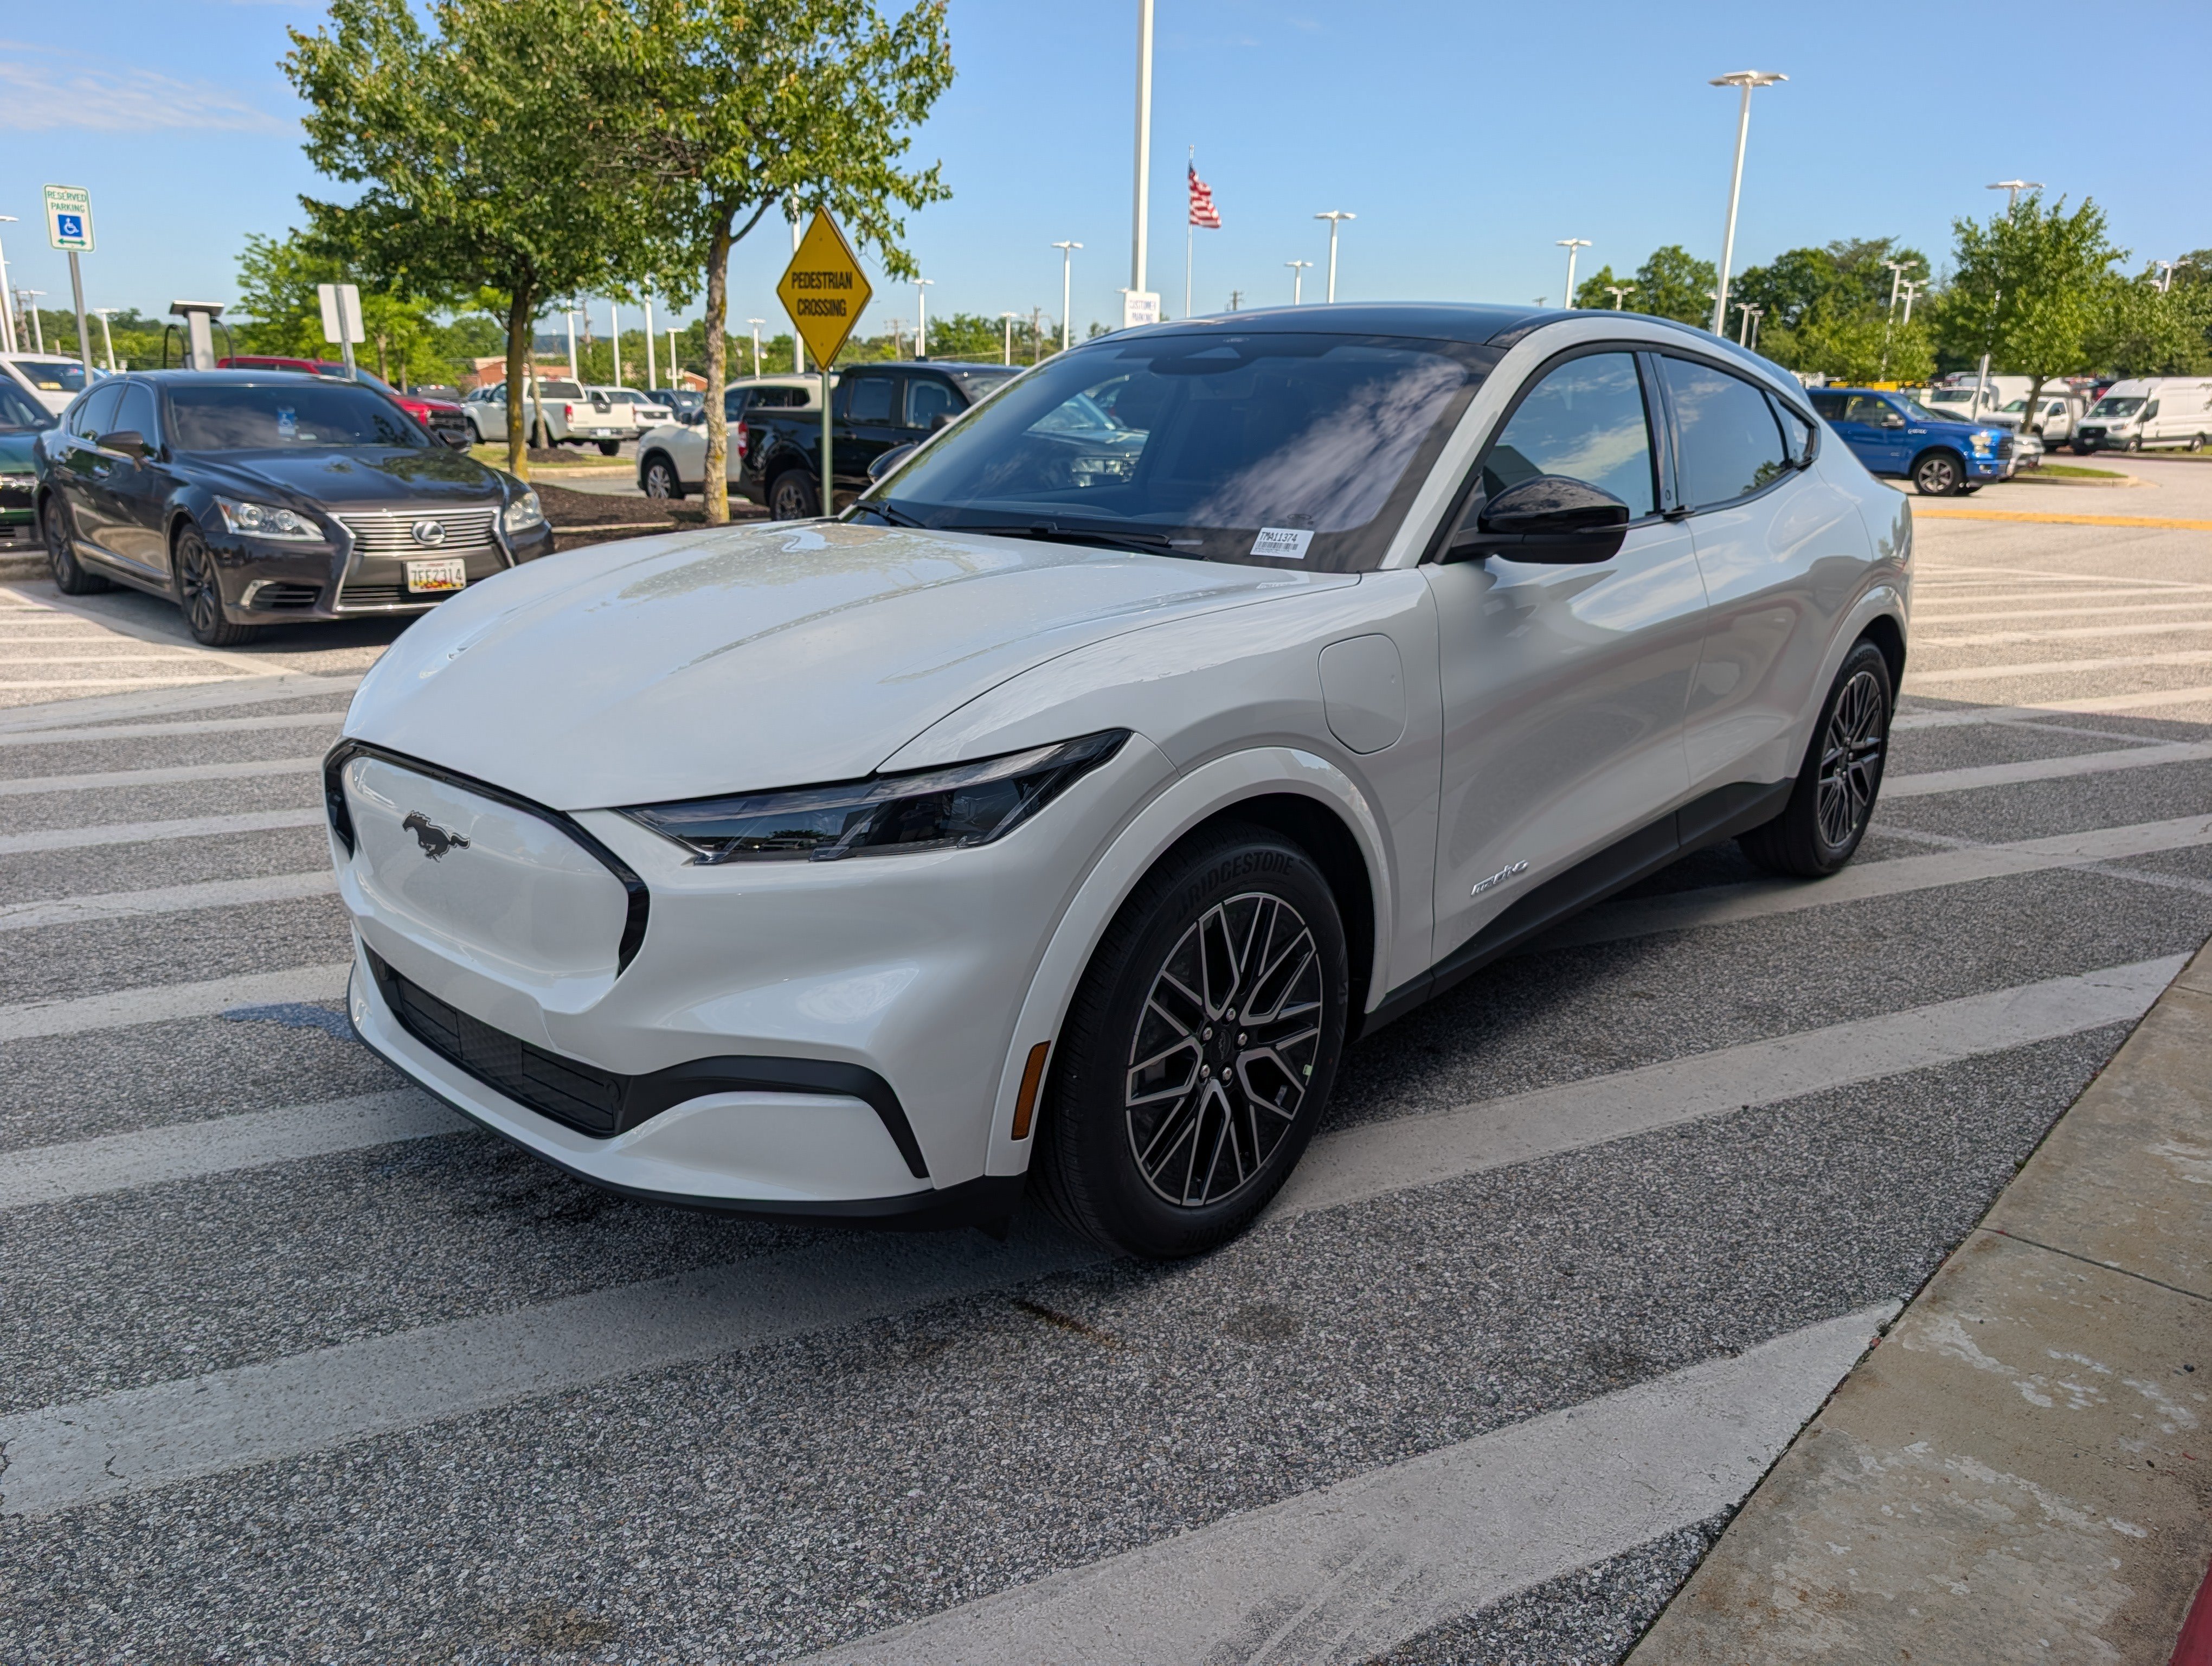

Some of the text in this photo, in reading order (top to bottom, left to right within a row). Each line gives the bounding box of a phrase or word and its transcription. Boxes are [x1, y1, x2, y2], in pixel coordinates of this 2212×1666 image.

[47, 190, 87, 202] RESERVED
[51, 202, 85, 213] PARKING
[791, 271, 853, 289] PEDESTRIAN
[797, 298, 847, 317] CROSSING
[1259, 531, 1298, 542] TMA11374
